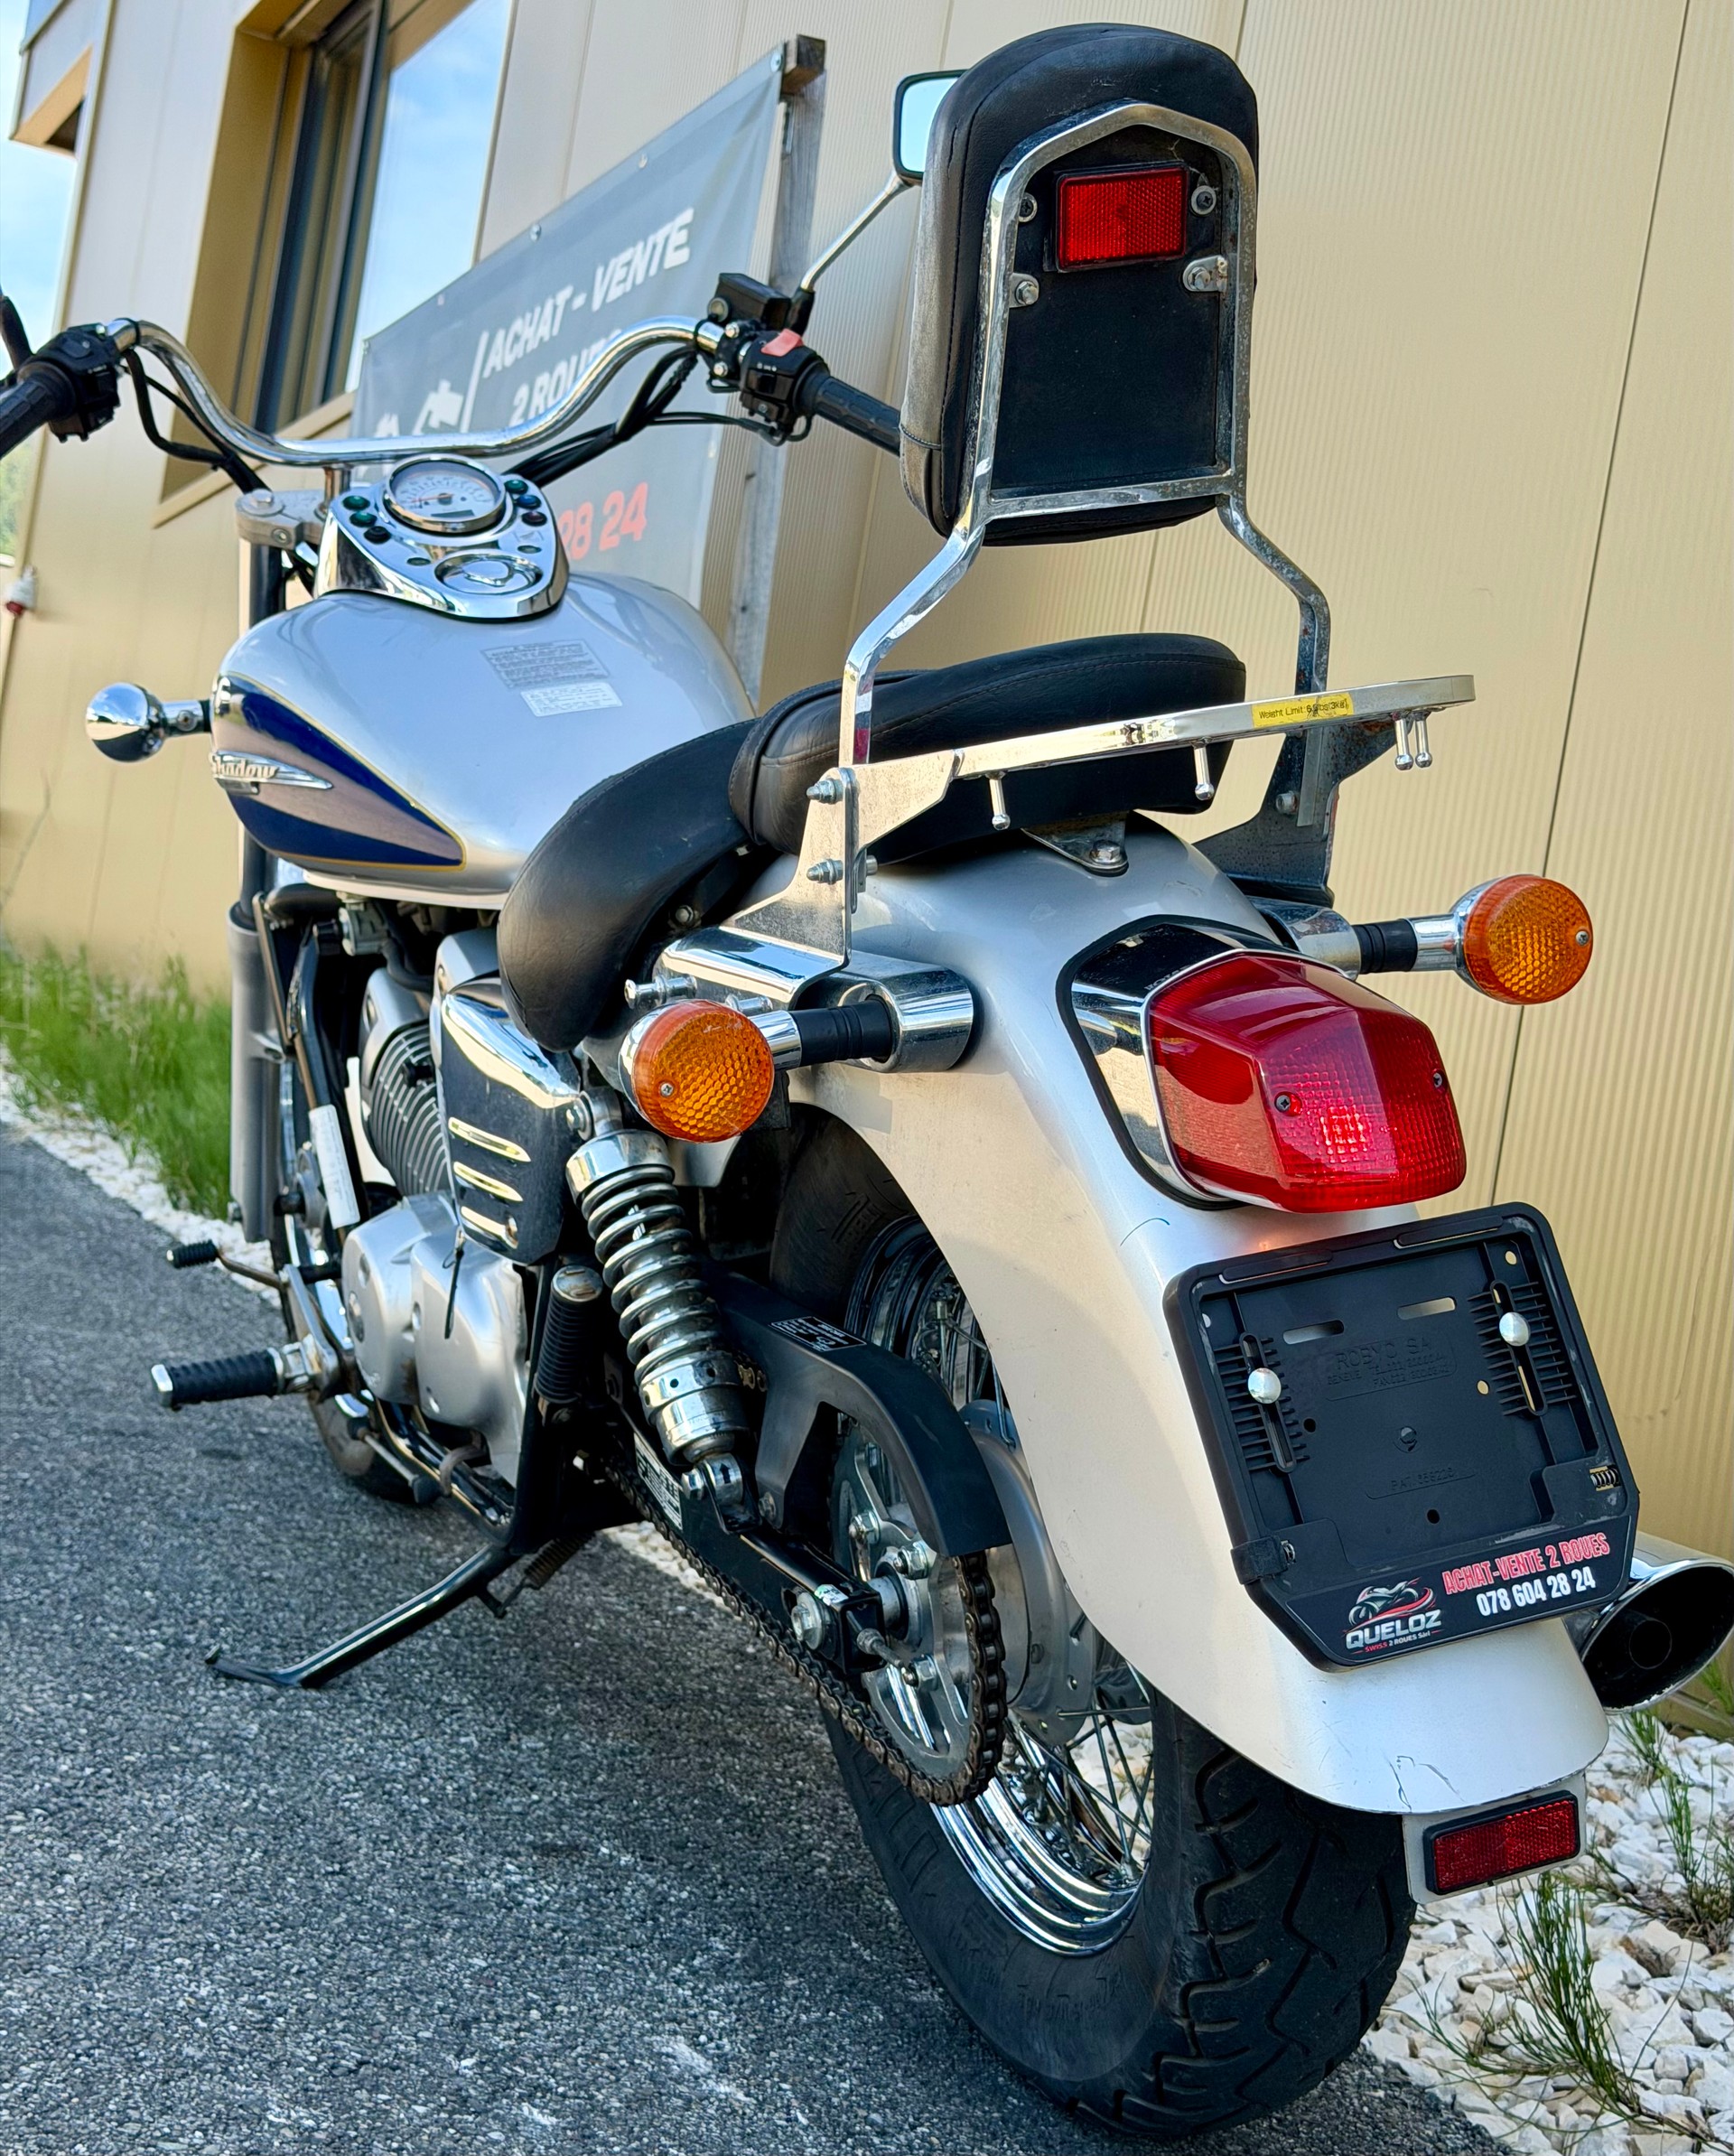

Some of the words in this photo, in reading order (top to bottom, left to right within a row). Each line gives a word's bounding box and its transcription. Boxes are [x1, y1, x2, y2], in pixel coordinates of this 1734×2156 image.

[483, 285, 574, 378] ACHAT
[592, 208, 694, 313] VENTE
[509, 382, 529, 426] 2
[598, 481, 648, 552] 24
[209, 752, 279, 779] Shadow
[1441, 1548, 1546, 1595] ACHAT-VENTE
[1545, 1545, 1560, 1569] 2
[1559, 1533, 1610, 1565] ROUES
[1476, 1588, 1512, 1616] 078
[1513, 1580, 1547, 1608] 604
[1546, 1573, 1571, 1599] 28
[1571, 1566, 1596, 1592] 24
[1346, 1610, 1442, 1649] QUELOZ
[1365, 1641, 1387, 1652] SWISS
[1394, 1634, 1417, 1646] ROUES
